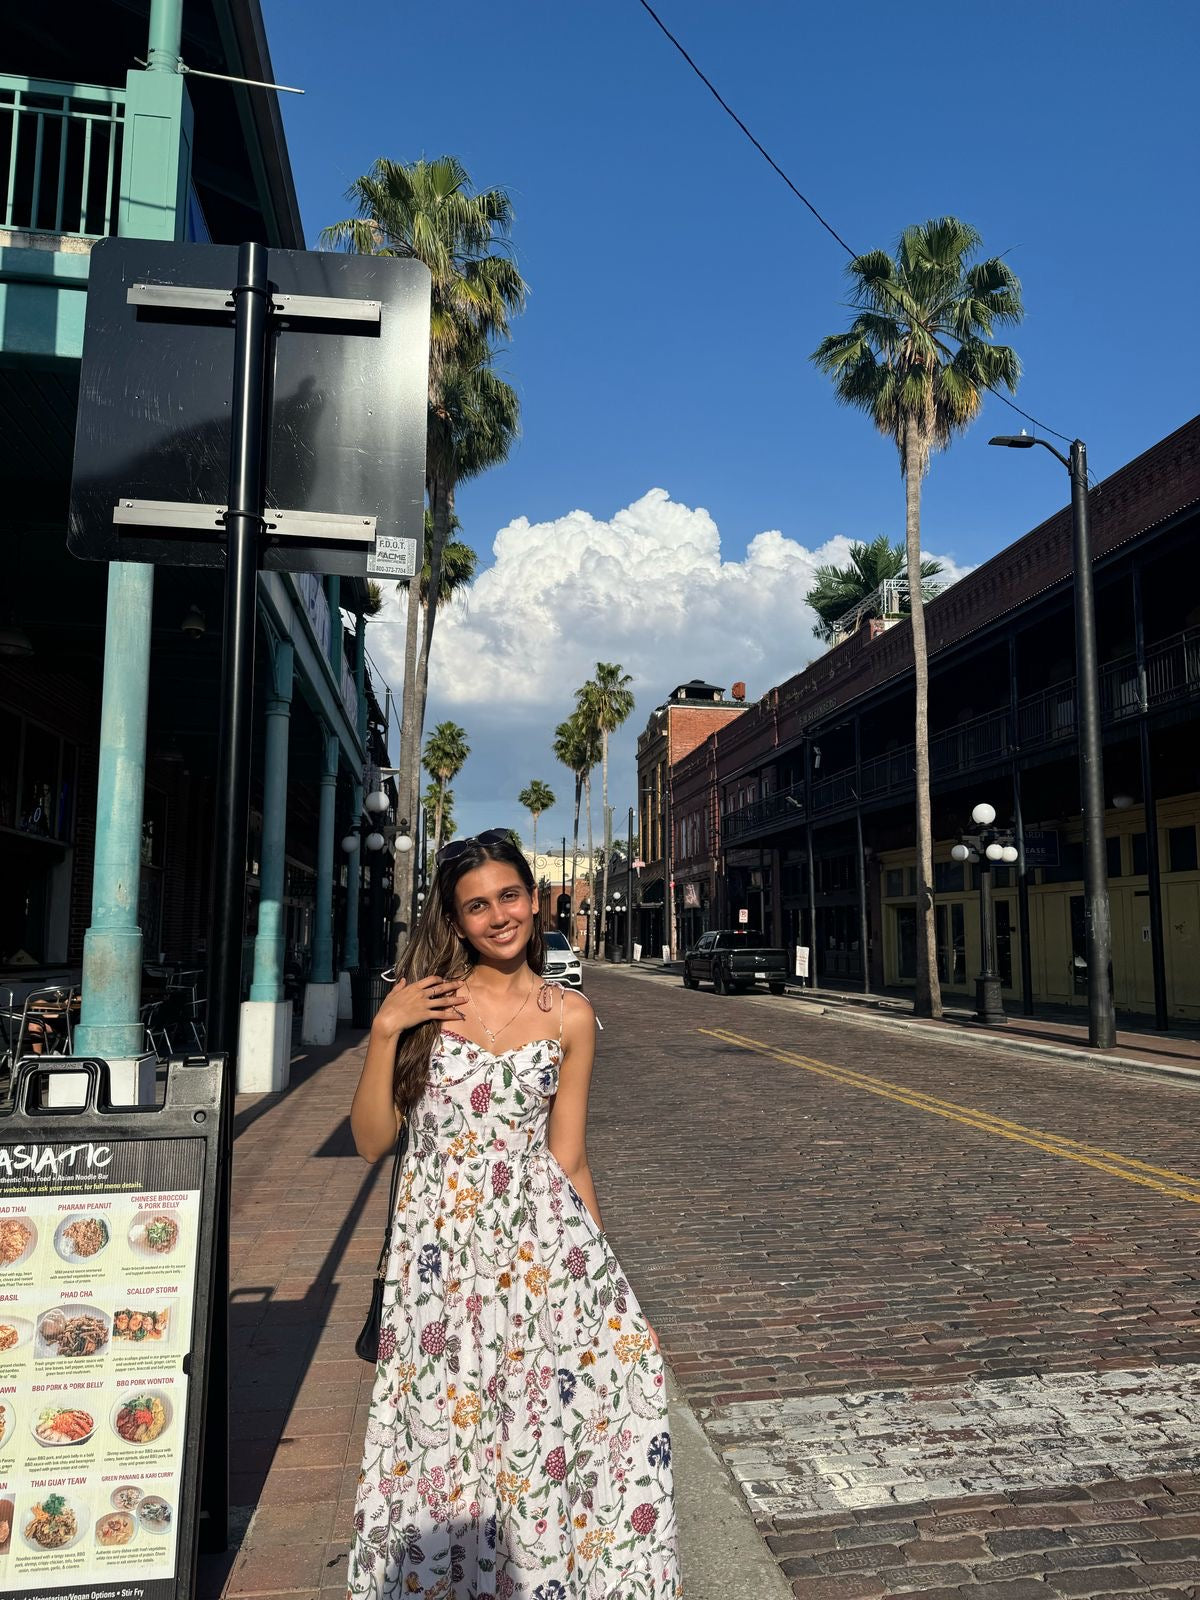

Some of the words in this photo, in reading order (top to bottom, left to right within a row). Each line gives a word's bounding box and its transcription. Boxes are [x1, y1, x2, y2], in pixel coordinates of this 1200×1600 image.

[380, 540, 406, 550] F.D.O.T.
[22, 1175, 36, 1183] Thai
[75, 1173, 97, 1181] Noodle
[84, 1182, 93, 1190] for
[130, 1195, 156, 1203] CHINESE
[12, 1205, 27, 1214] THAI
[58, 1203, 86, 1211] PHARAM
[87, 1202, 112, 1210] PEANUT
[162, 1201, 180, 1209] BELLY
[61, 1290, 79, 1298] PHAD
[80, 1289, 93, 1297] CHA
[127, 1287, 155, 1296] SCALLOP
[156, 1286, 178, 1294] STORM
[147, 1377, 174, 1385] WONTON
[32, 1384, 46, 1392] BBQ
[86, 1381, 104, 1389] BELLY
[31, 1480, 47, 1488] THAI
[47, 1479, 67, 1487] GUAY
[67, 1477, 87, 1486] TEAW
[91, 1591, 115, 1600] Options
[121, 1588, 133, 1597] Stir
[133, 1587, 145, 1597] Fry
